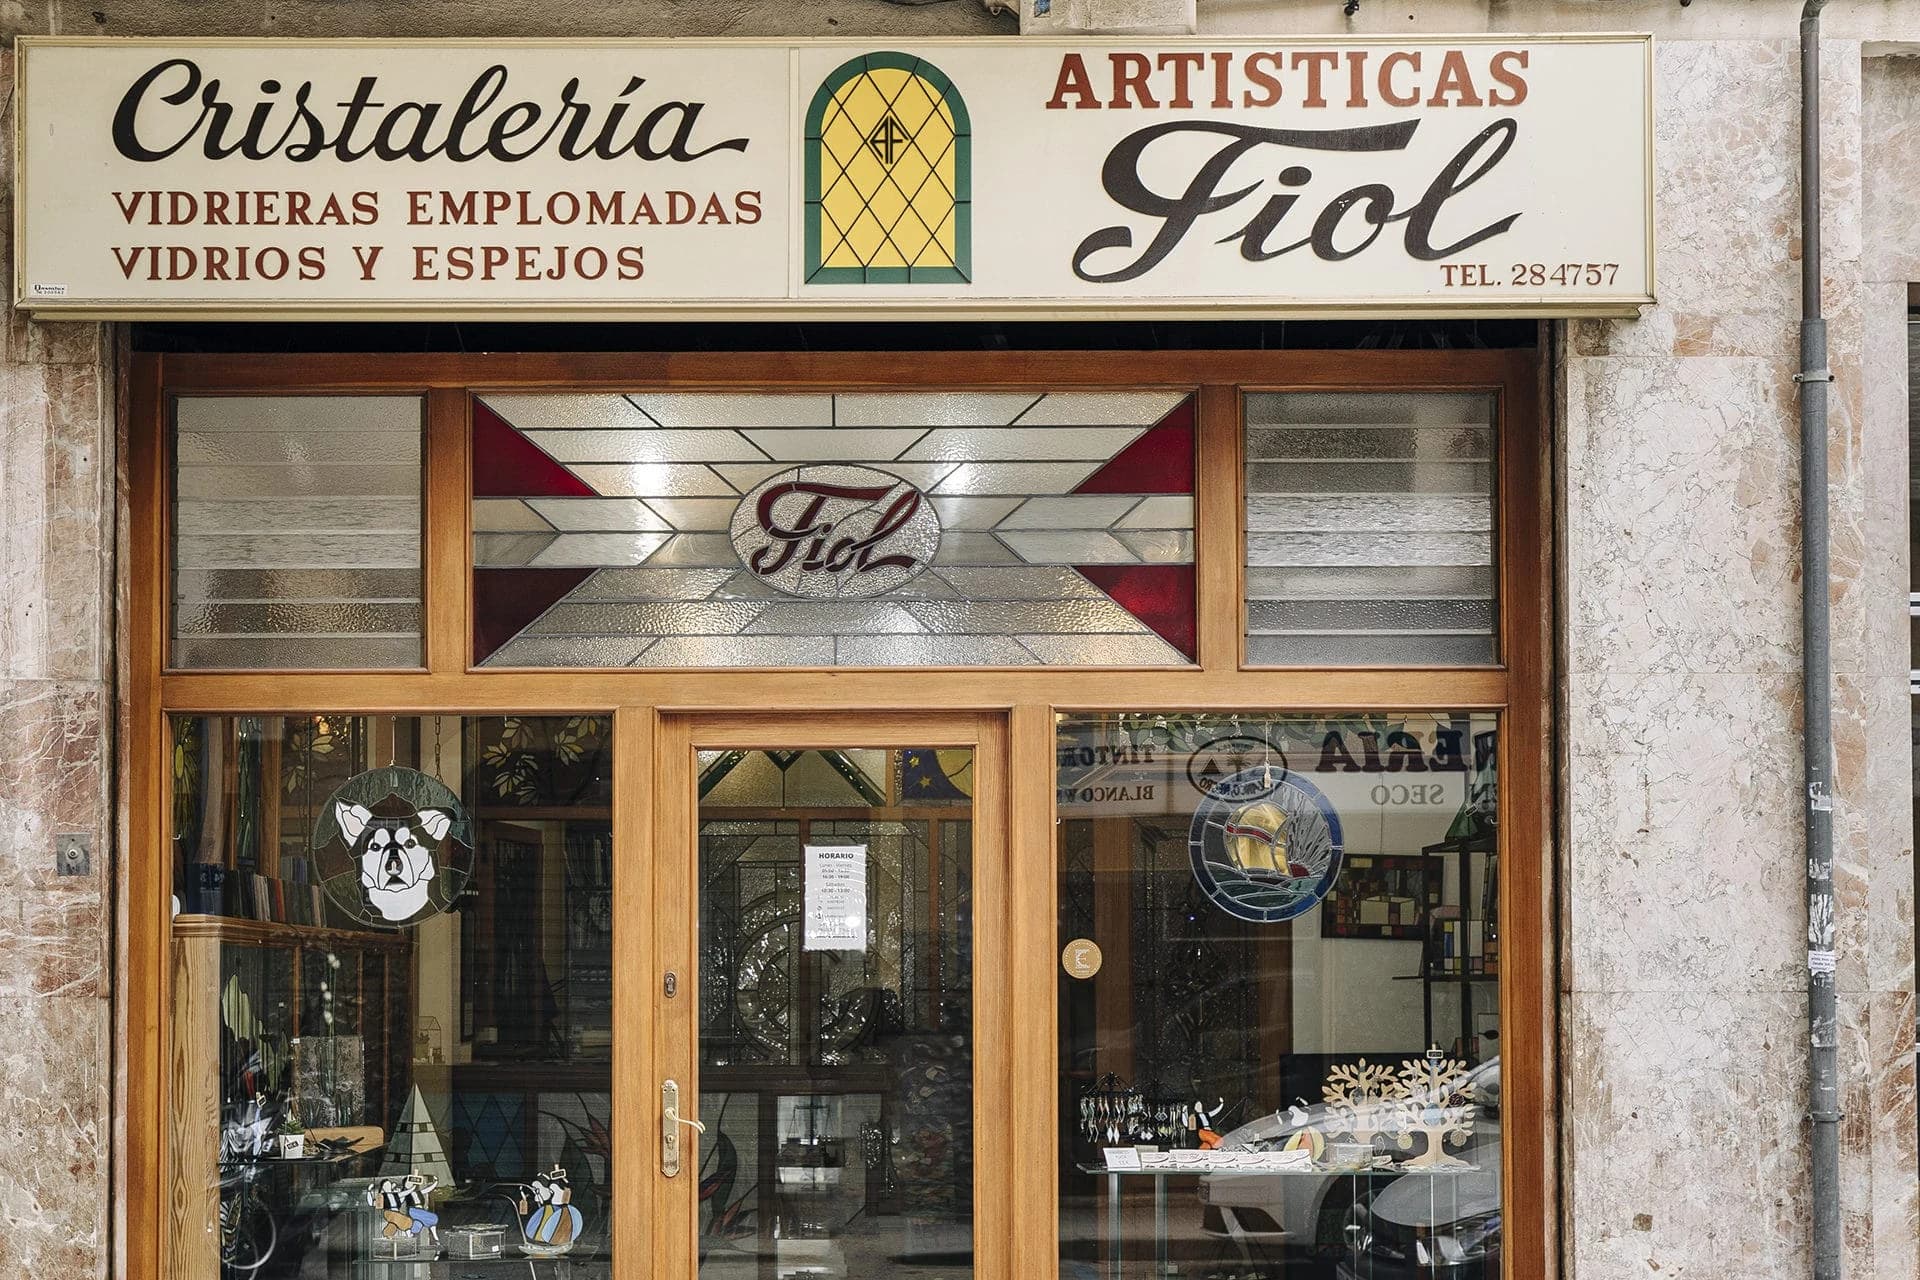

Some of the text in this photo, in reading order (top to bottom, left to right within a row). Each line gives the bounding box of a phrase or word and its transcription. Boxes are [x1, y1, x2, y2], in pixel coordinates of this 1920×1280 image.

[1045, 50, 1530, 109] ARTISTICAS
[111, 57, 749, 163] Cristalería
[111, 190, 763, 226] VIDRIERAS EMPLOMADAS
[1071, 117, 1521, 284] Fiol
[111, 246, 645, 281] VIDRIOS Y ESPEJOS
[1440, 263, 1620, 287] TEL. 284757
[750, 480, 921, 576] Fiol
